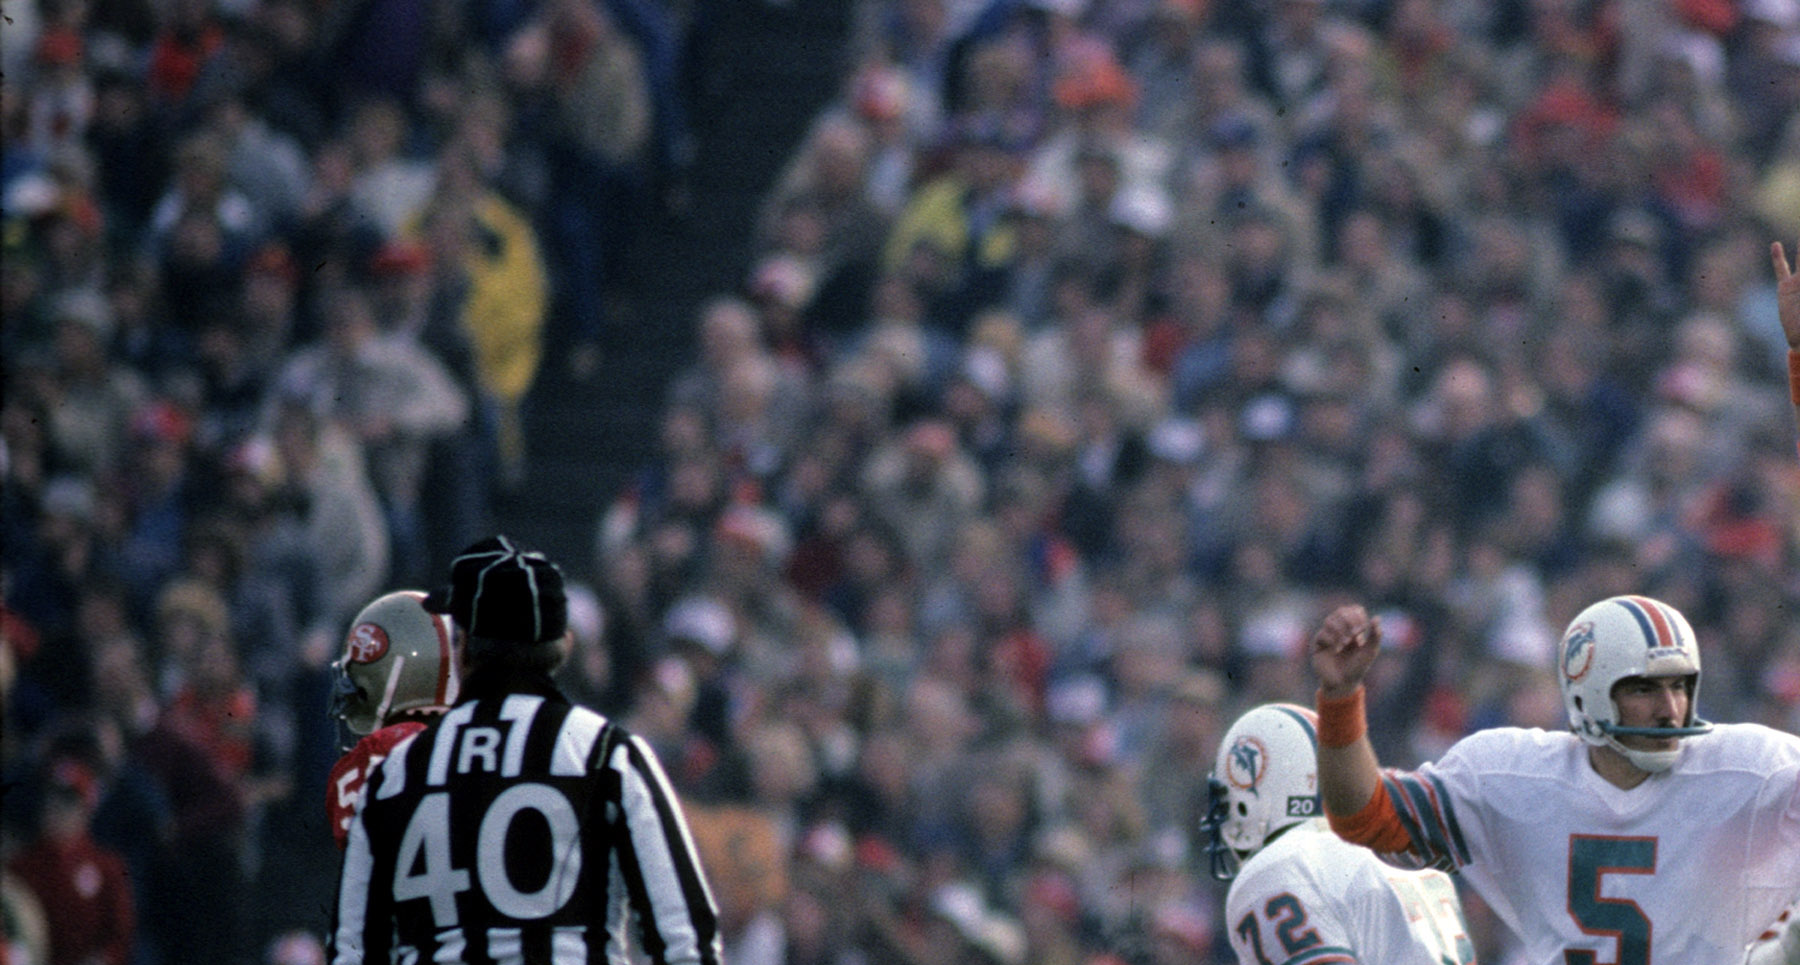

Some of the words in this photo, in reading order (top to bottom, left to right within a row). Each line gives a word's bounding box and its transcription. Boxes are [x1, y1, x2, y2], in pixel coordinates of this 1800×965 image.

[457, 727, 500, 773] R
[1290, 799, 1314, 815] 20
[392, 782, 581, 927] 40
